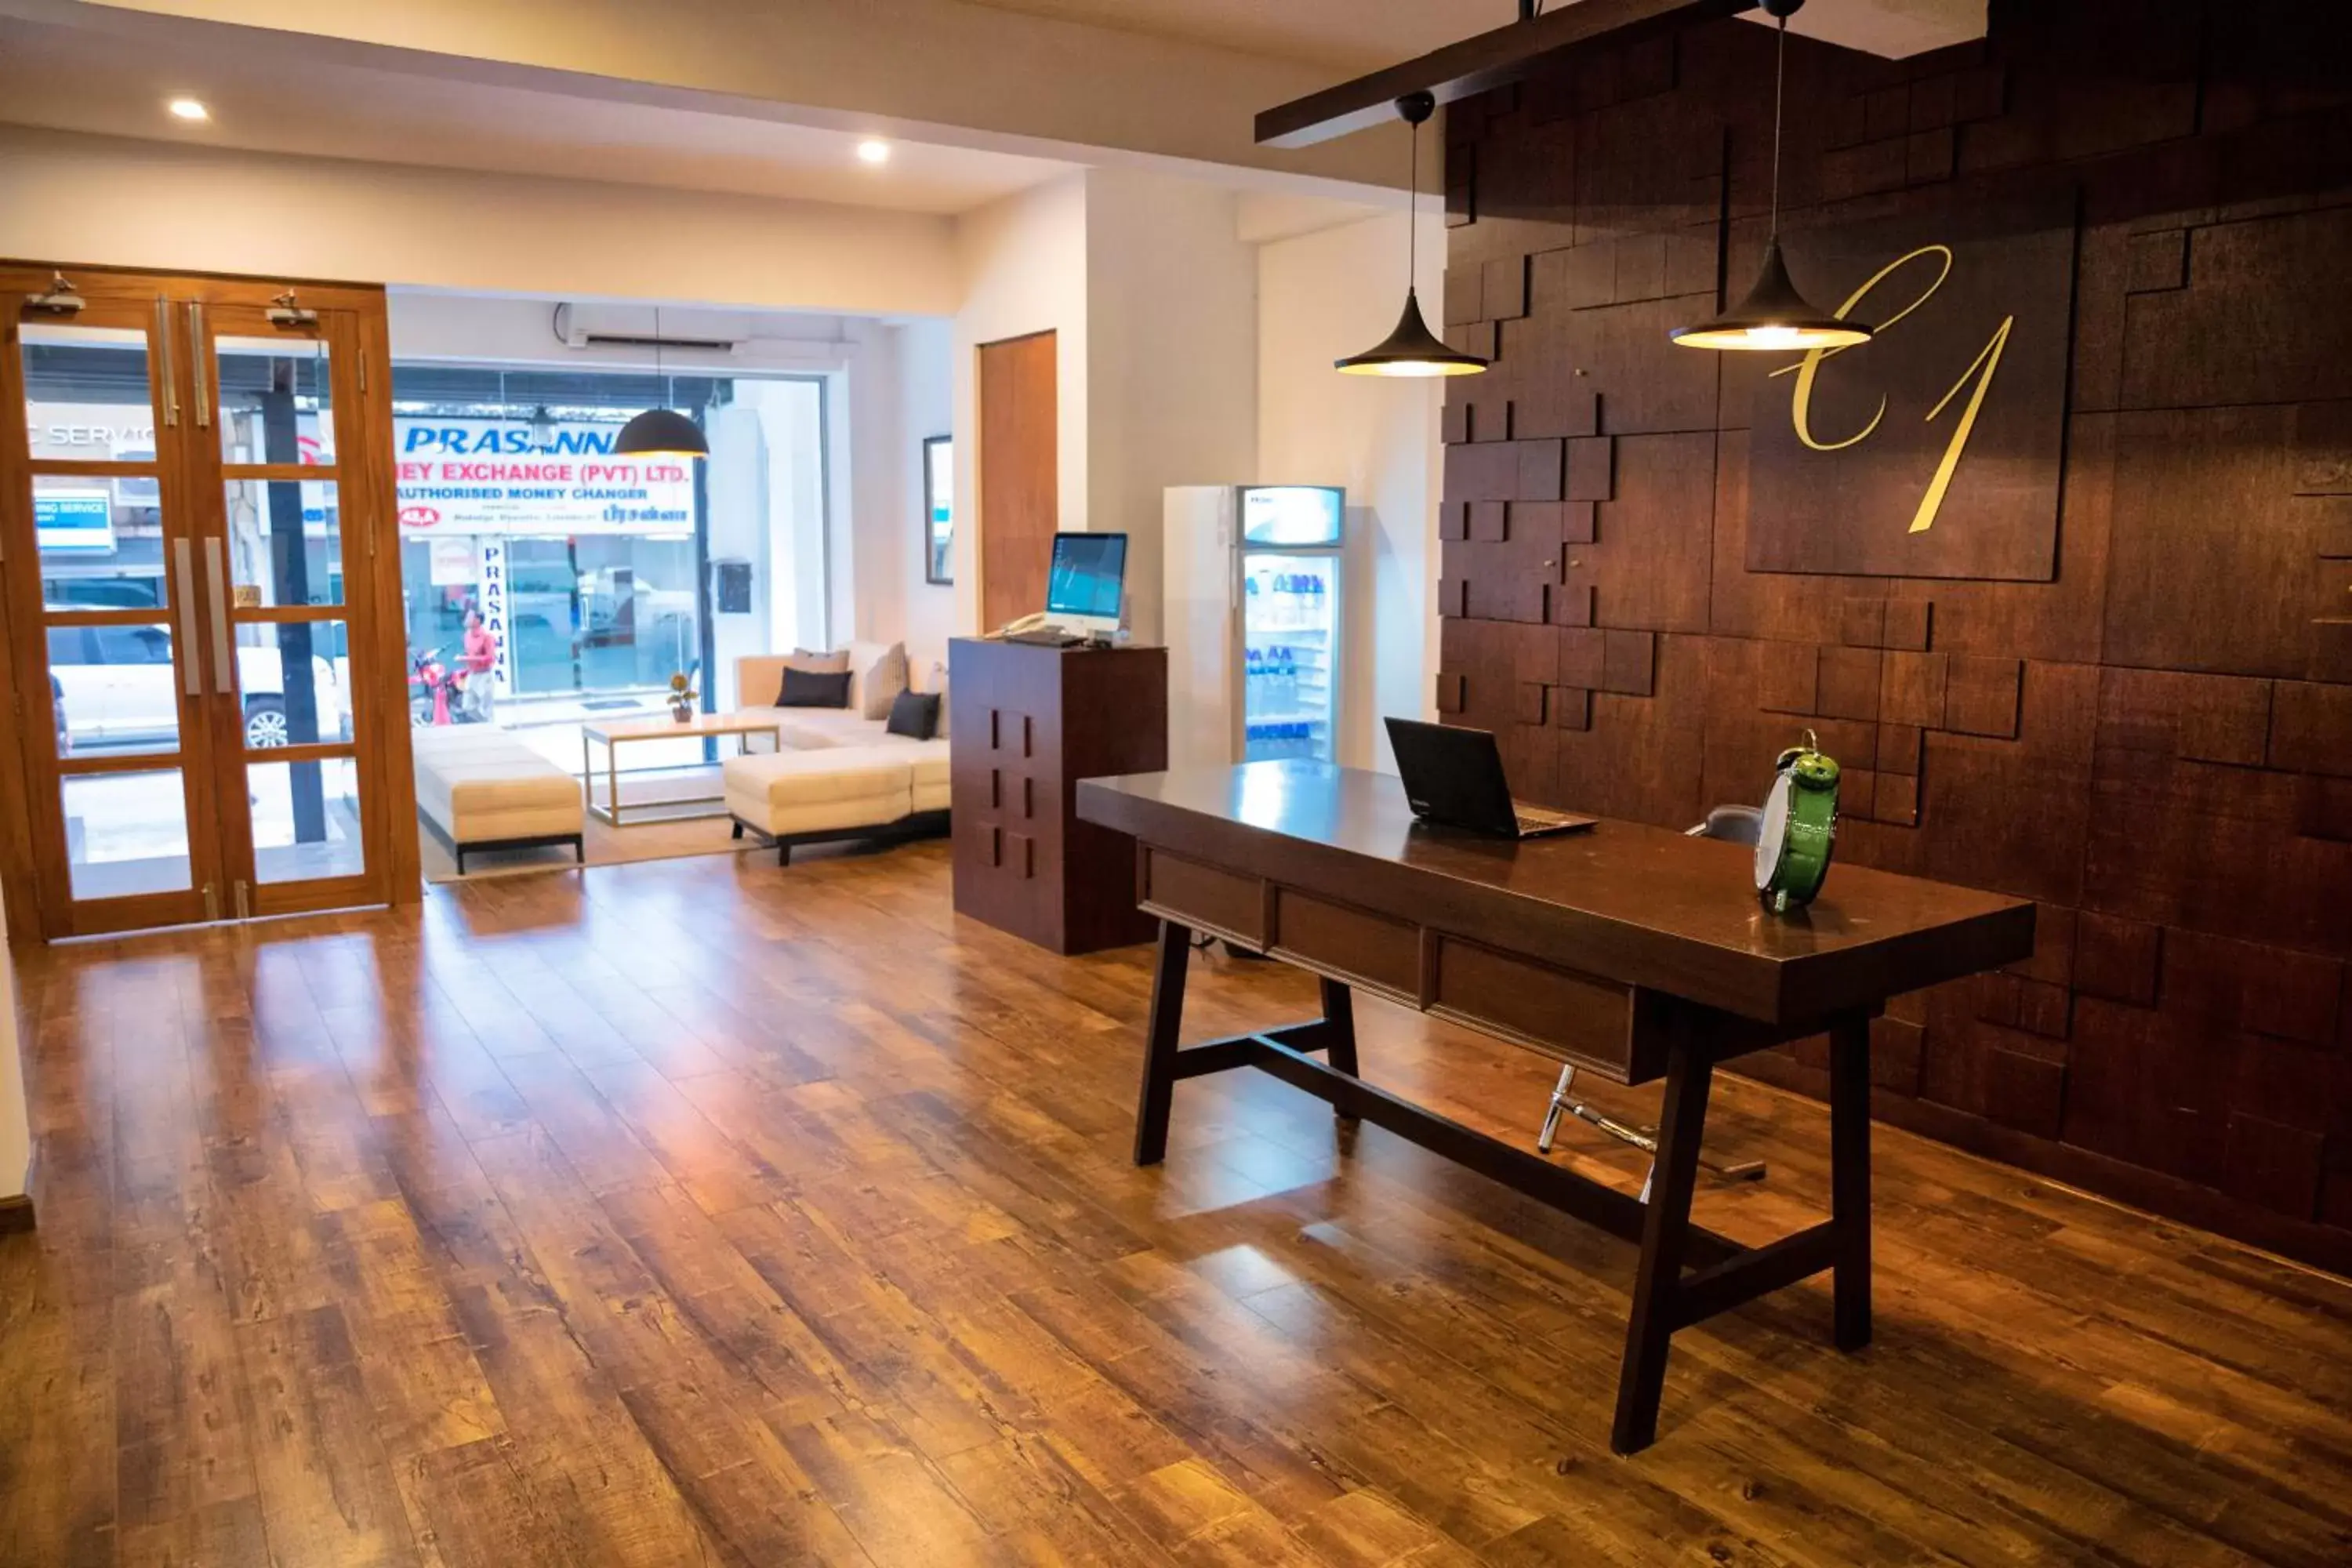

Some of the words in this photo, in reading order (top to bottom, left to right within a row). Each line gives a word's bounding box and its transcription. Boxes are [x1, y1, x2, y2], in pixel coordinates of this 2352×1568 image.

[441, 463, 573, 482] EXCHANGE
[579, 464, 638, 486] (PVT)
[645, 465, 690, 483] LTD.
[508, 487, 566, 500] MONEY
[572, 487, 648, 500] CHANGER
[60, 503, 105, 514] SERVICE
